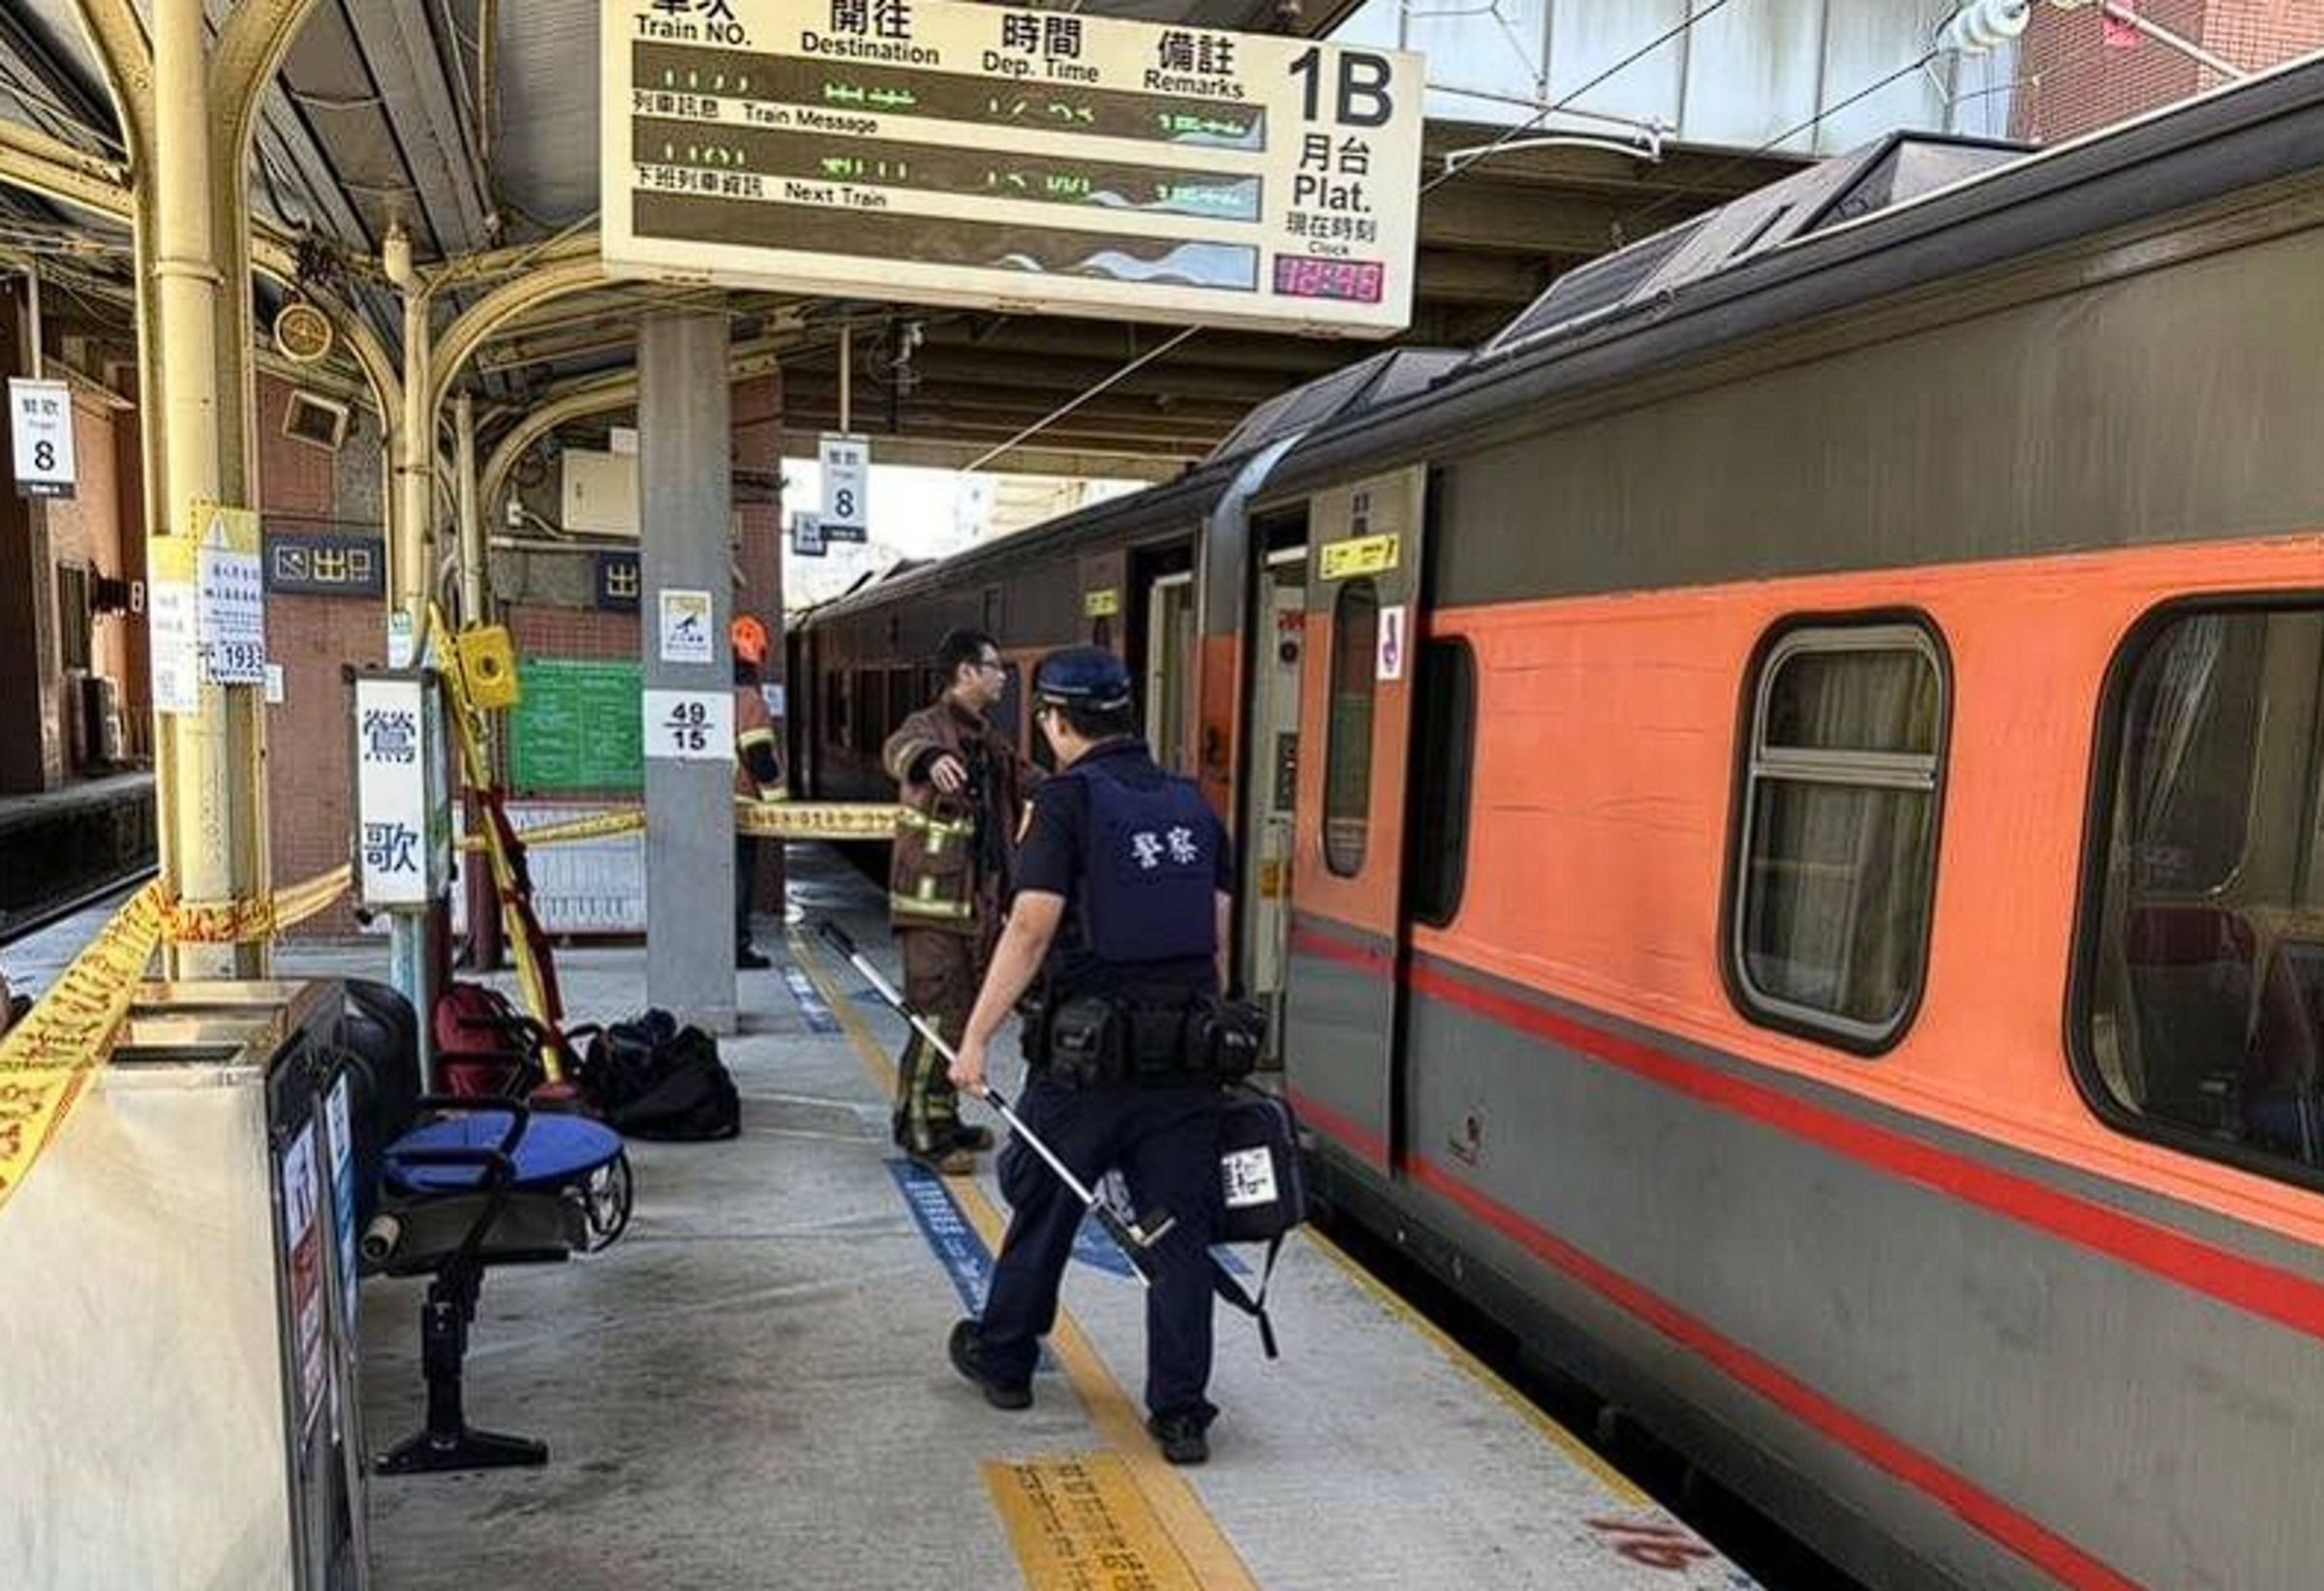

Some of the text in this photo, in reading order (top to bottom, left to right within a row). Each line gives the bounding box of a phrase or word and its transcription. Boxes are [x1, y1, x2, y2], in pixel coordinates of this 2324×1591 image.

[634, 14, 751, 45] Train NO.
[831, 0, 912, 39] 開往
[1001, 14, 1082, 58] 時間
[801, 31, 940, 65] Destination
[1159, 30, 1235, 75] 備註
[982, 49, 1100, 83] Dep. Time
[1144, 70, 1244, 99] Remarks
[1289, 46, 1392, 128] 1B
[744, 103, 878, 134] Train Message
[1300, 133, 1370, 175] 月台
[785, 181, 887, 208] Next Train
[1294, 173, 1371, 213] Plat.
[1285, 211, 1376, 243] 現在時刻
[1308, 239, 1349, 256] Clock
[34, 440, 55, 472] 8
[835, 487, 854, 518] 8
[314, 547, 371, 583] 出口
[607, 562, 637, 597] 出
[672, 702, 706, 724] 49
[673, 730, 706, 750] 15
[364, 710, 418, 872] 鶯歌
[1132, 825, 1198, 870] 警察
